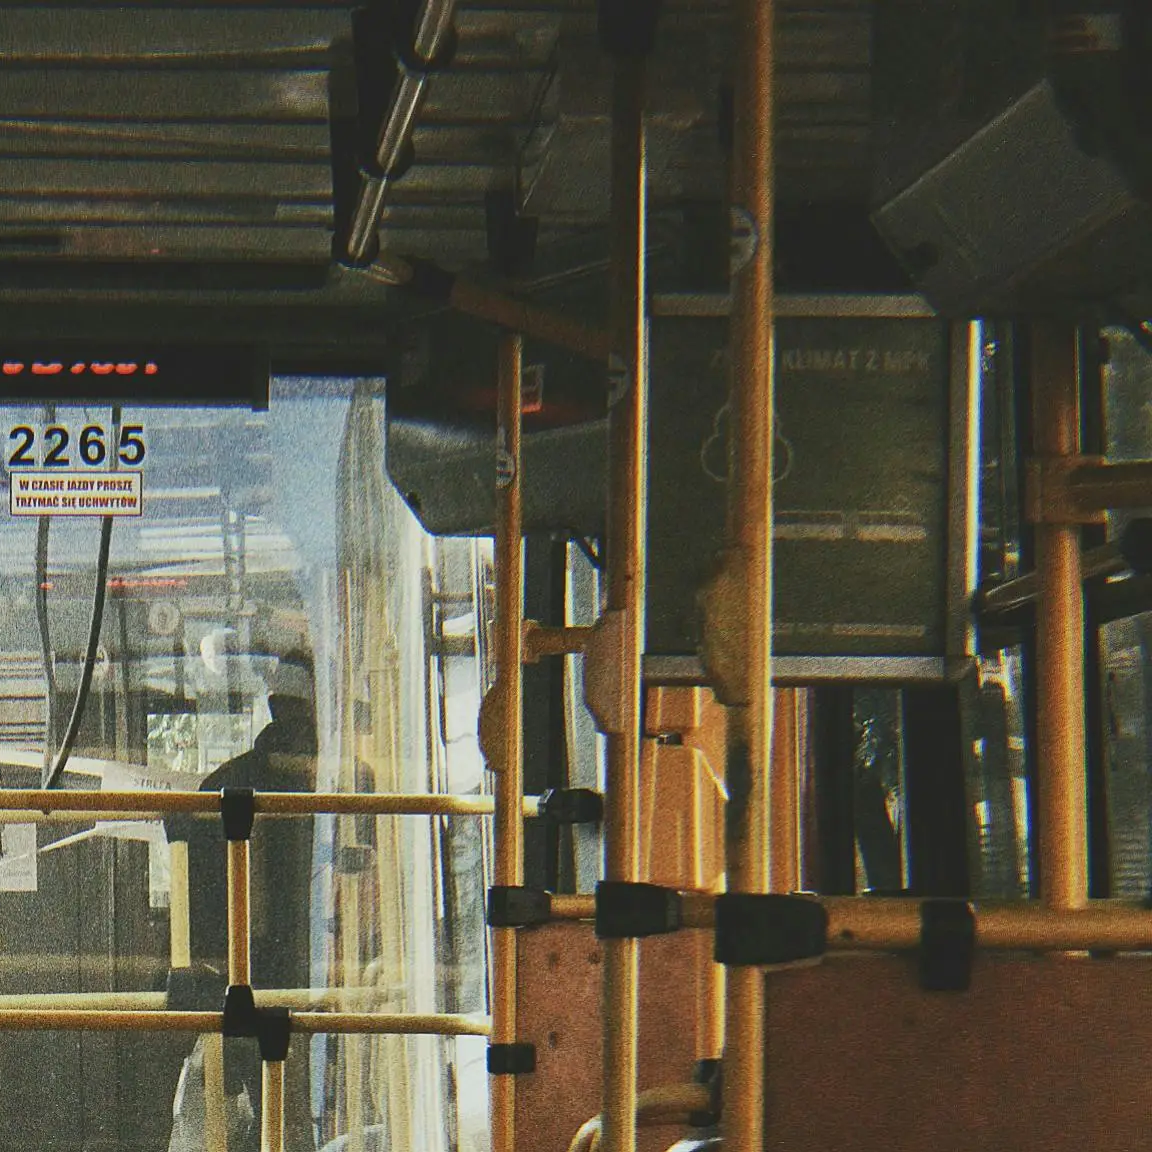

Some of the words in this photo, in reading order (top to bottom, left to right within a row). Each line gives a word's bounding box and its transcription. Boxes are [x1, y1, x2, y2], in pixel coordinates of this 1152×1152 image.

[781, 348, 860, 370] KLIMAT
[8, 425, 146, 467] 2265
[19, 479, 29, 491] W
[31, 479, 65, 491] CZASIE
[67, 479, 95, 491] JAZDY
[97, 479, 133, 493] PROSZĘ
[16, 496, 60, 508] TRZYMAĆ
[61, 496, 76, 509] SIĘ
[78, 496, 137, 508] UCHWYTÓW
